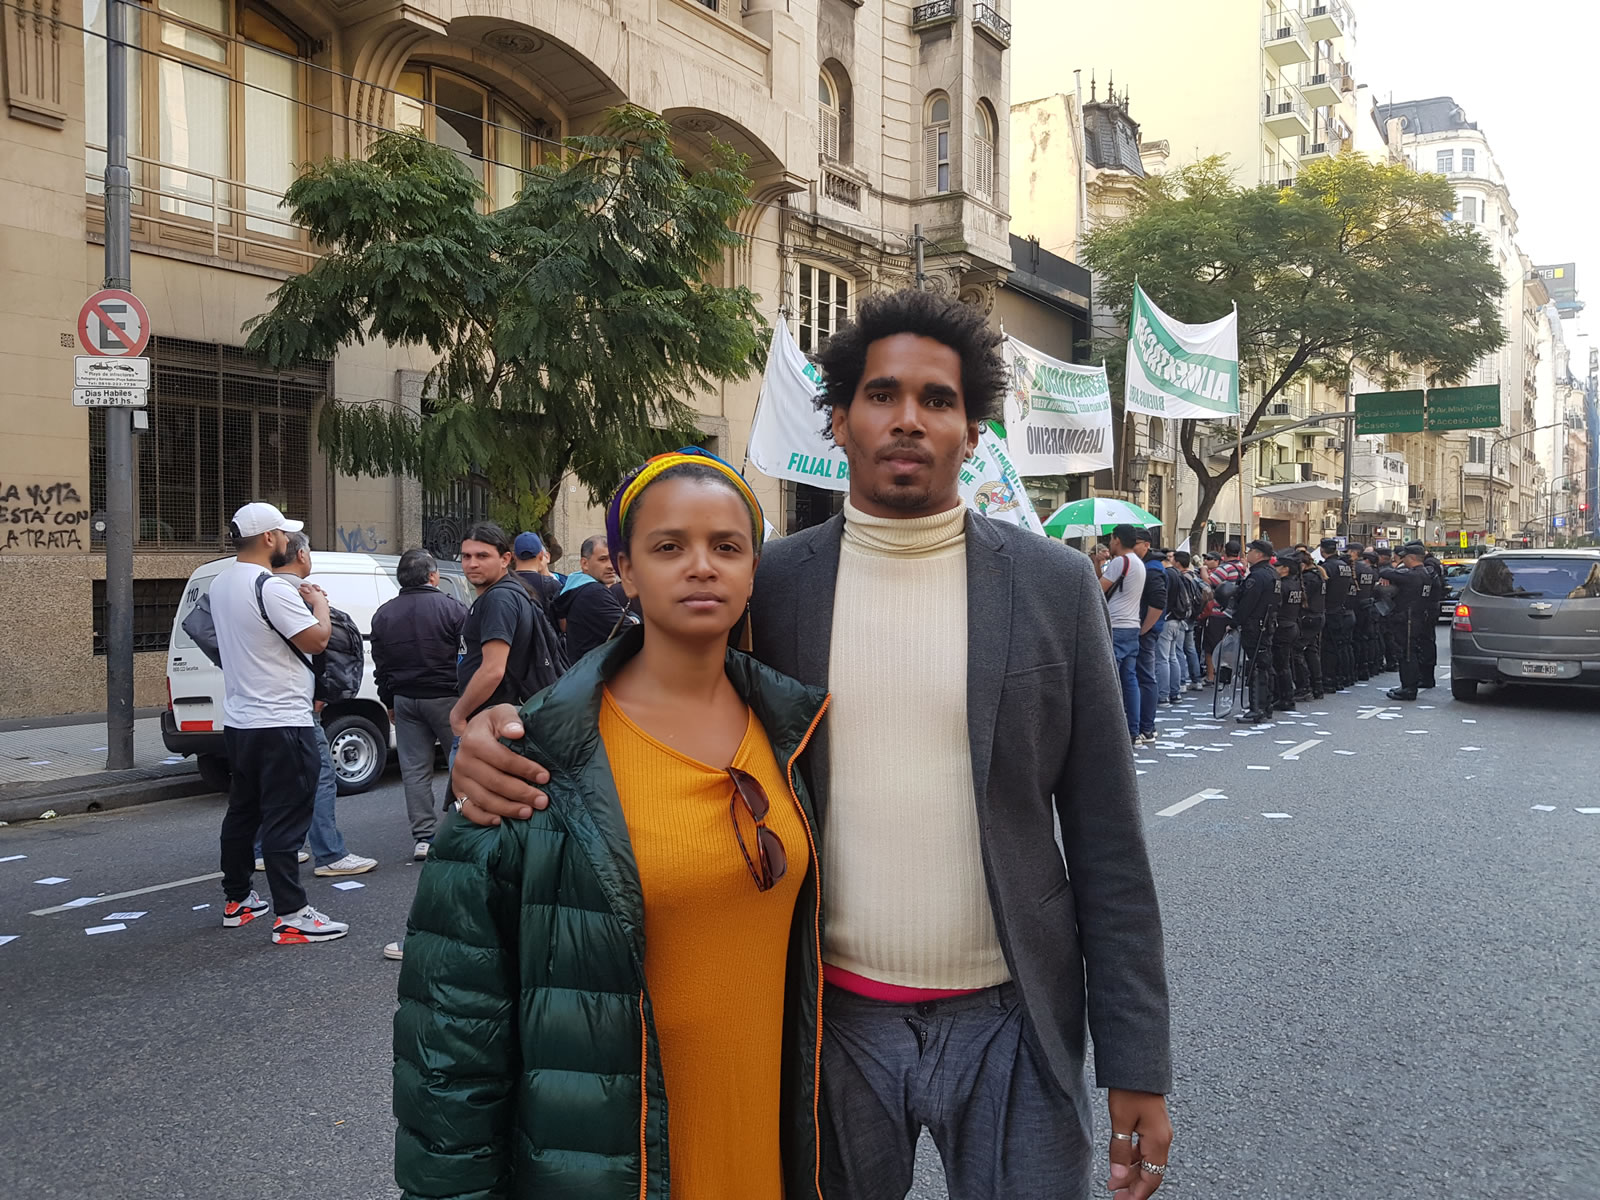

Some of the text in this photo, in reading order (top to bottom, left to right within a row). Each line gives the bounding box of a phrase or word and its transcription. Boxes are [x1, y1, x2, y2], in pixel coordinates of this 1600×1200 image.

[99, 304, 128, 349] E
[1437, 416, 1498, 426] Acceso Norte
[787, 452, 832, 477] FILIAL
[967, 455, 986, 472] TA
[54, 510, 89, 525] CON
[20, 528, 82, 550] TRATA
[187, 587, 200, 603] 110
